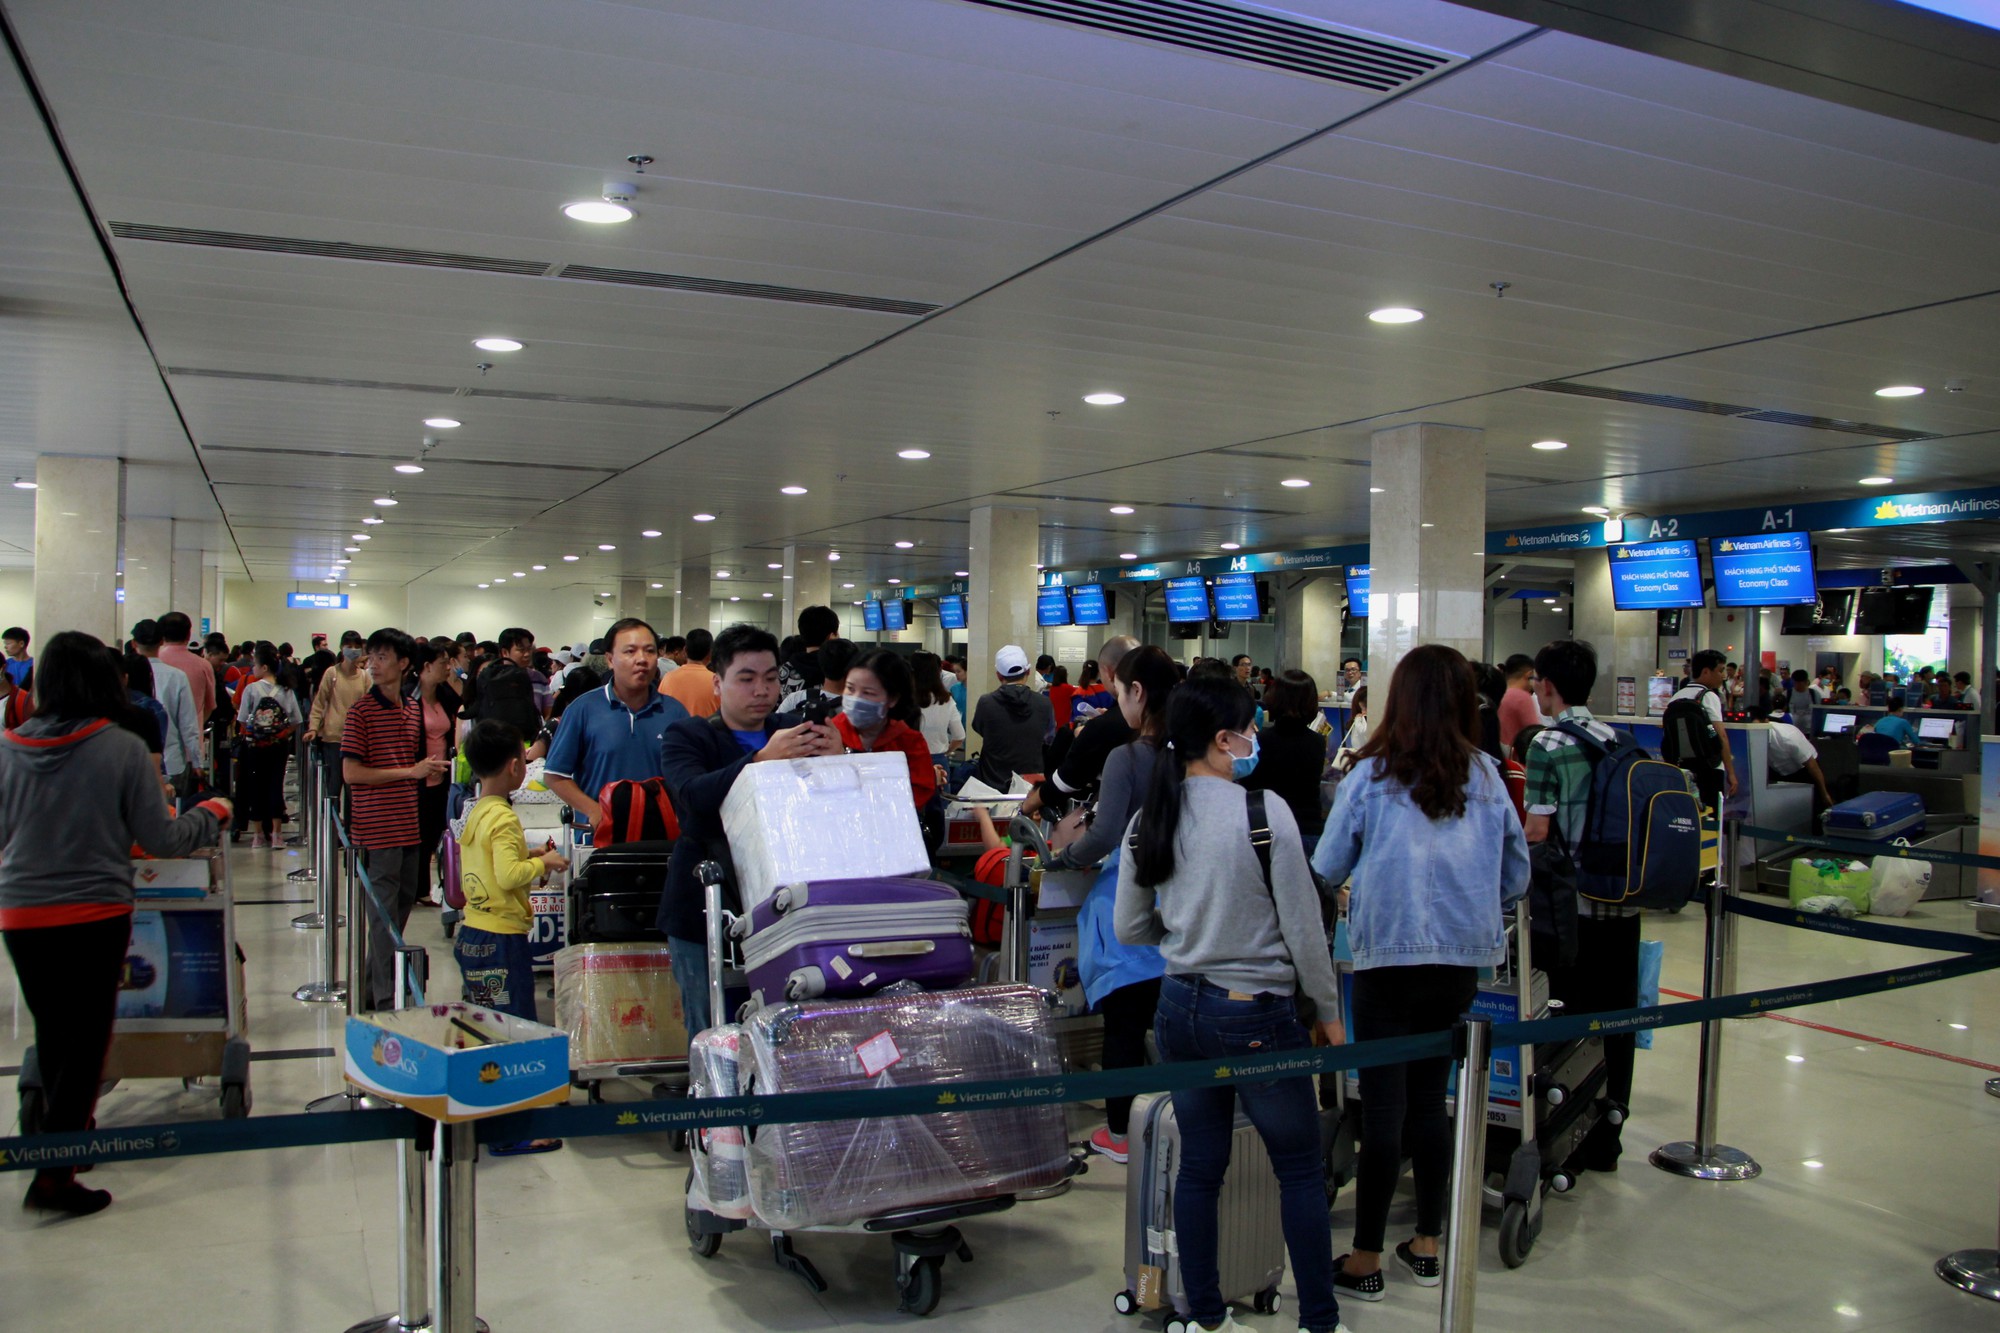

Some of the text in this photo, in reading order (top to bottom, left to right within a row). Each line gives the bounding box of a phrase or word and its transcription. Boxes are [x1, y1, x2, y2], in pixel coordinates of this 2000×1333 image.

[1898, 498, 2000, 517] Vietnam Airlines
[1762, 508, 1793, 530] A-1
[1649, 518, 1678, 538] A-2
[1518, 531, 1579, 546] Vietnam Airlines
[1732, 539, 1791, 551] Vietnam Airlines
[1283, 554, 1324, 564] Vietnam Airlines
[1628, 546, 1681, 558] Vietnam Airlines
[1187, 562, 1200, 574] A-6
[1088, 571, 1099, 582] A-7
[1738, 578, 1789, 589] Economy Class
[1634, 583, 1679, 593] Economy Class
[1601, 1015, 1655, 1029] Vietnam Airlines
[503, 1059, 546, 1077] VIAGS
[1233, 1059, 1311, 1076] Vietnam Airlines
[959, 1086, 1050, 1103] Vietnam Airlines
[641, 1106, 746, 1123] Vietnam Airlines
[9, 1136, 156, 1163] Vietnam Airlines
[1137, 1273, 1149, 1304] Priority
